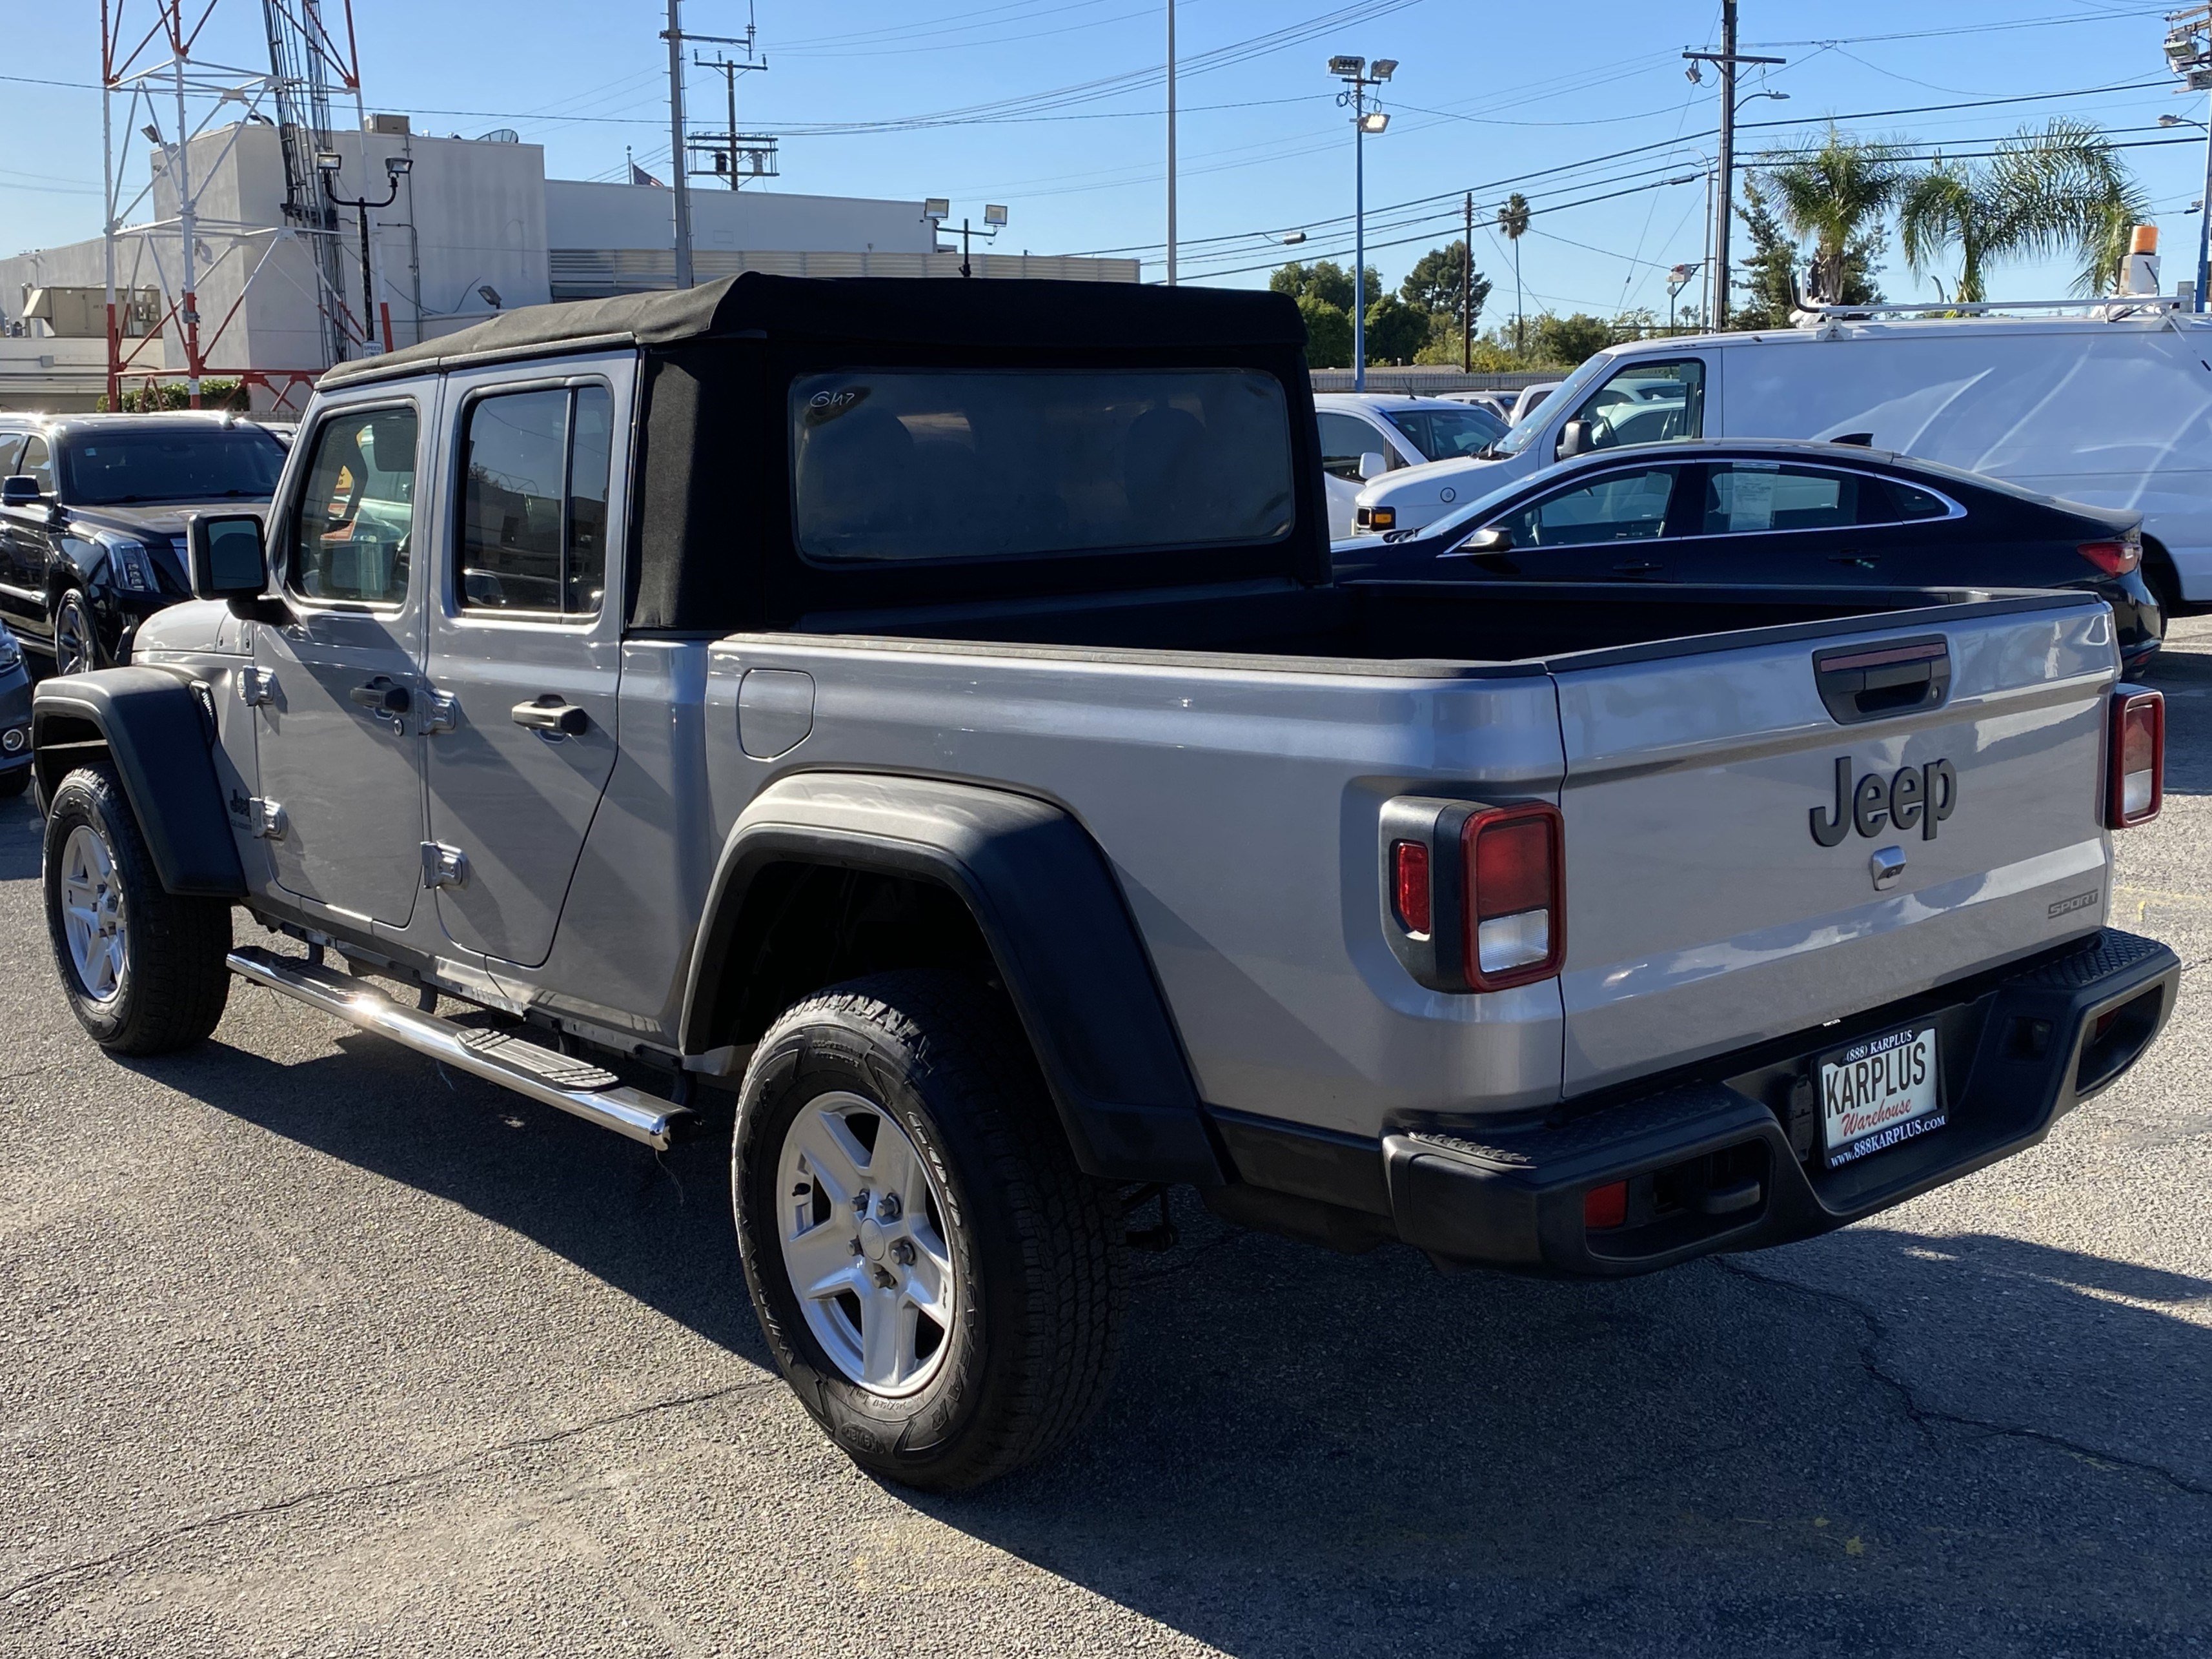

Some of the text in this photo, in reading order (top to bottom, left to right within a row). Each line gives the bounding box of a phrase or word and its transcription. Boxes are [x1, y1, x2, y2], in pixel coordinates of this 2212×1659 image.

[1809, 756, 1957, 847] Jeep
[2048, 890, 2098, 917] SPORT
[1846, 1029, 1913, 1063] (888) KARPLUS
[1825, 1041, 1926, 1119] KARPLUS
[1841, 1098, 1911, 1137] Warehouse
